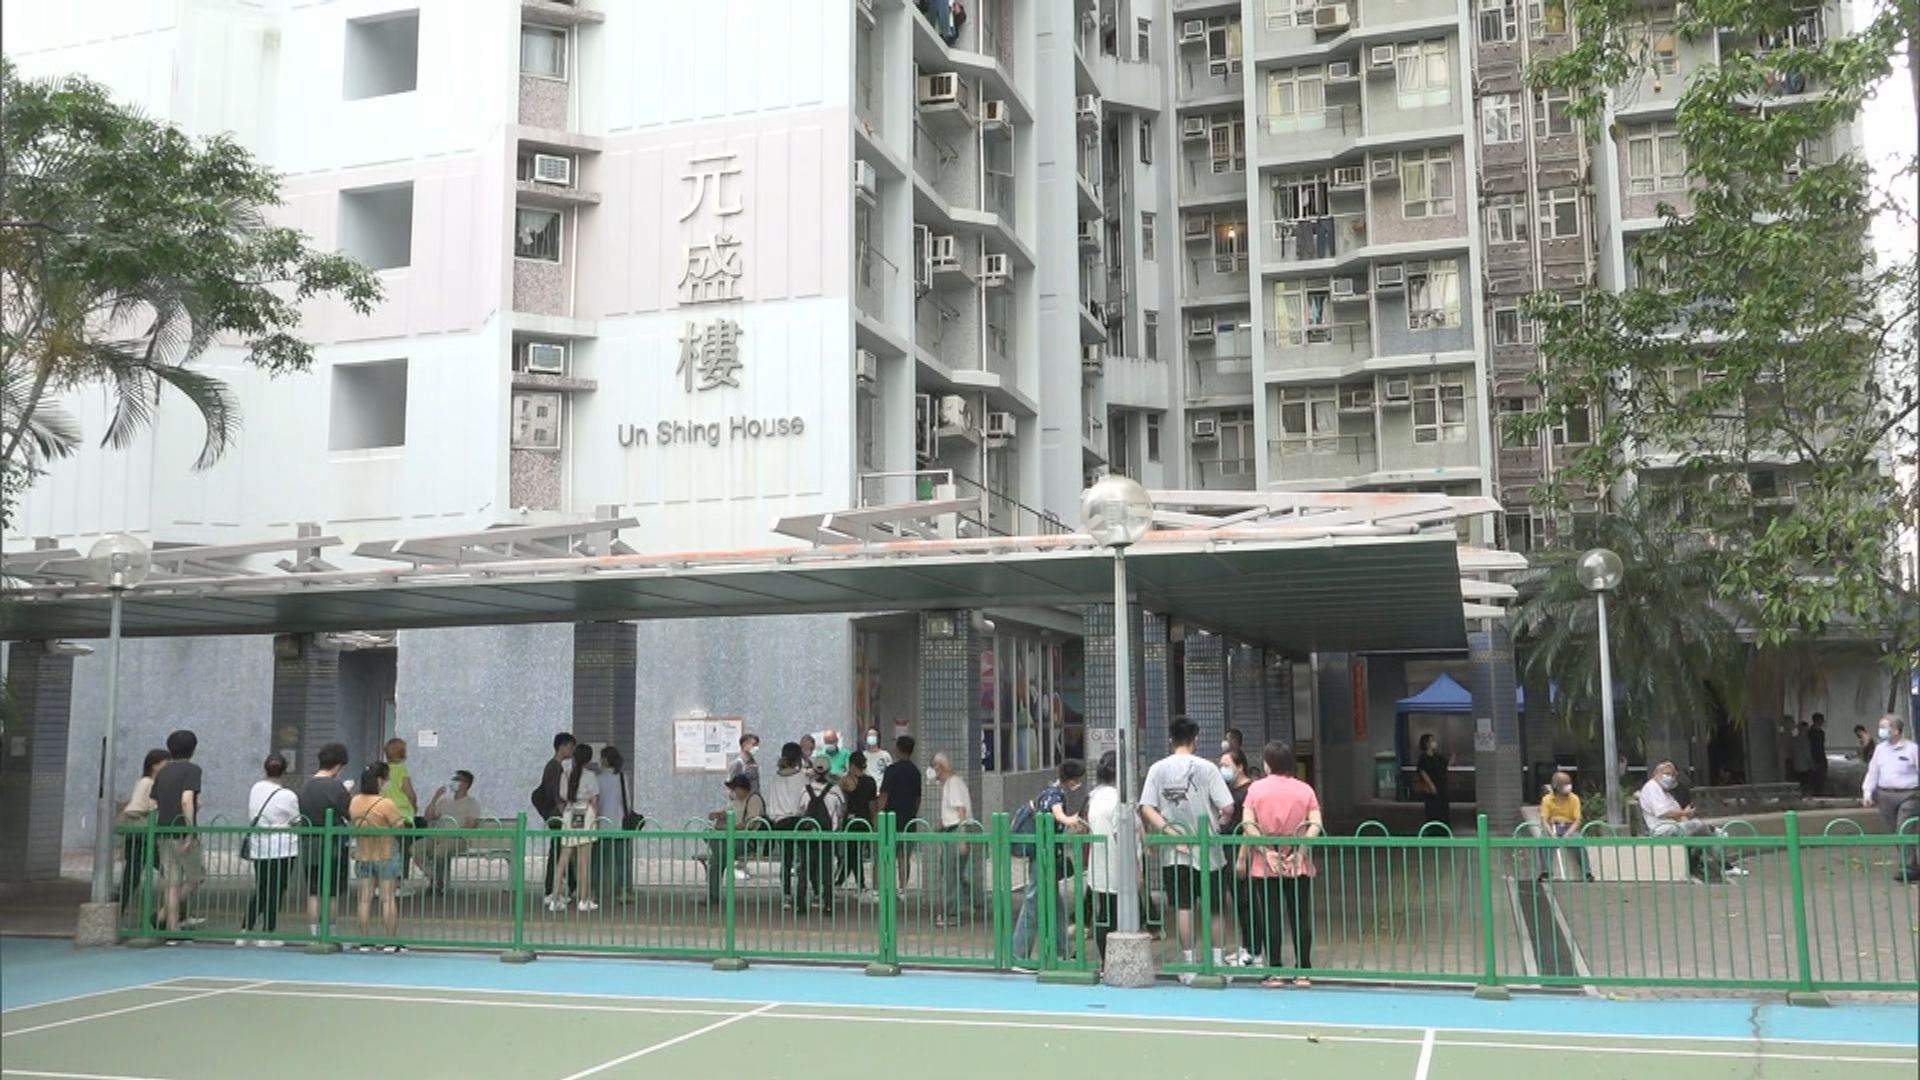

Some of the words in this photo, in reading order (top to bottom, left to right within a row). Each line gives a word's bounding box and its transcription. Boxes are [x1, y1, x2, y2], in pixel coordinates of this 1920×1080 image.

[676, 153, 744, 393] 元盛樓
[617, 423, 649, 448] Un
[656, 419, 721, 447] Shing
[729, 415, 805, 440] House
